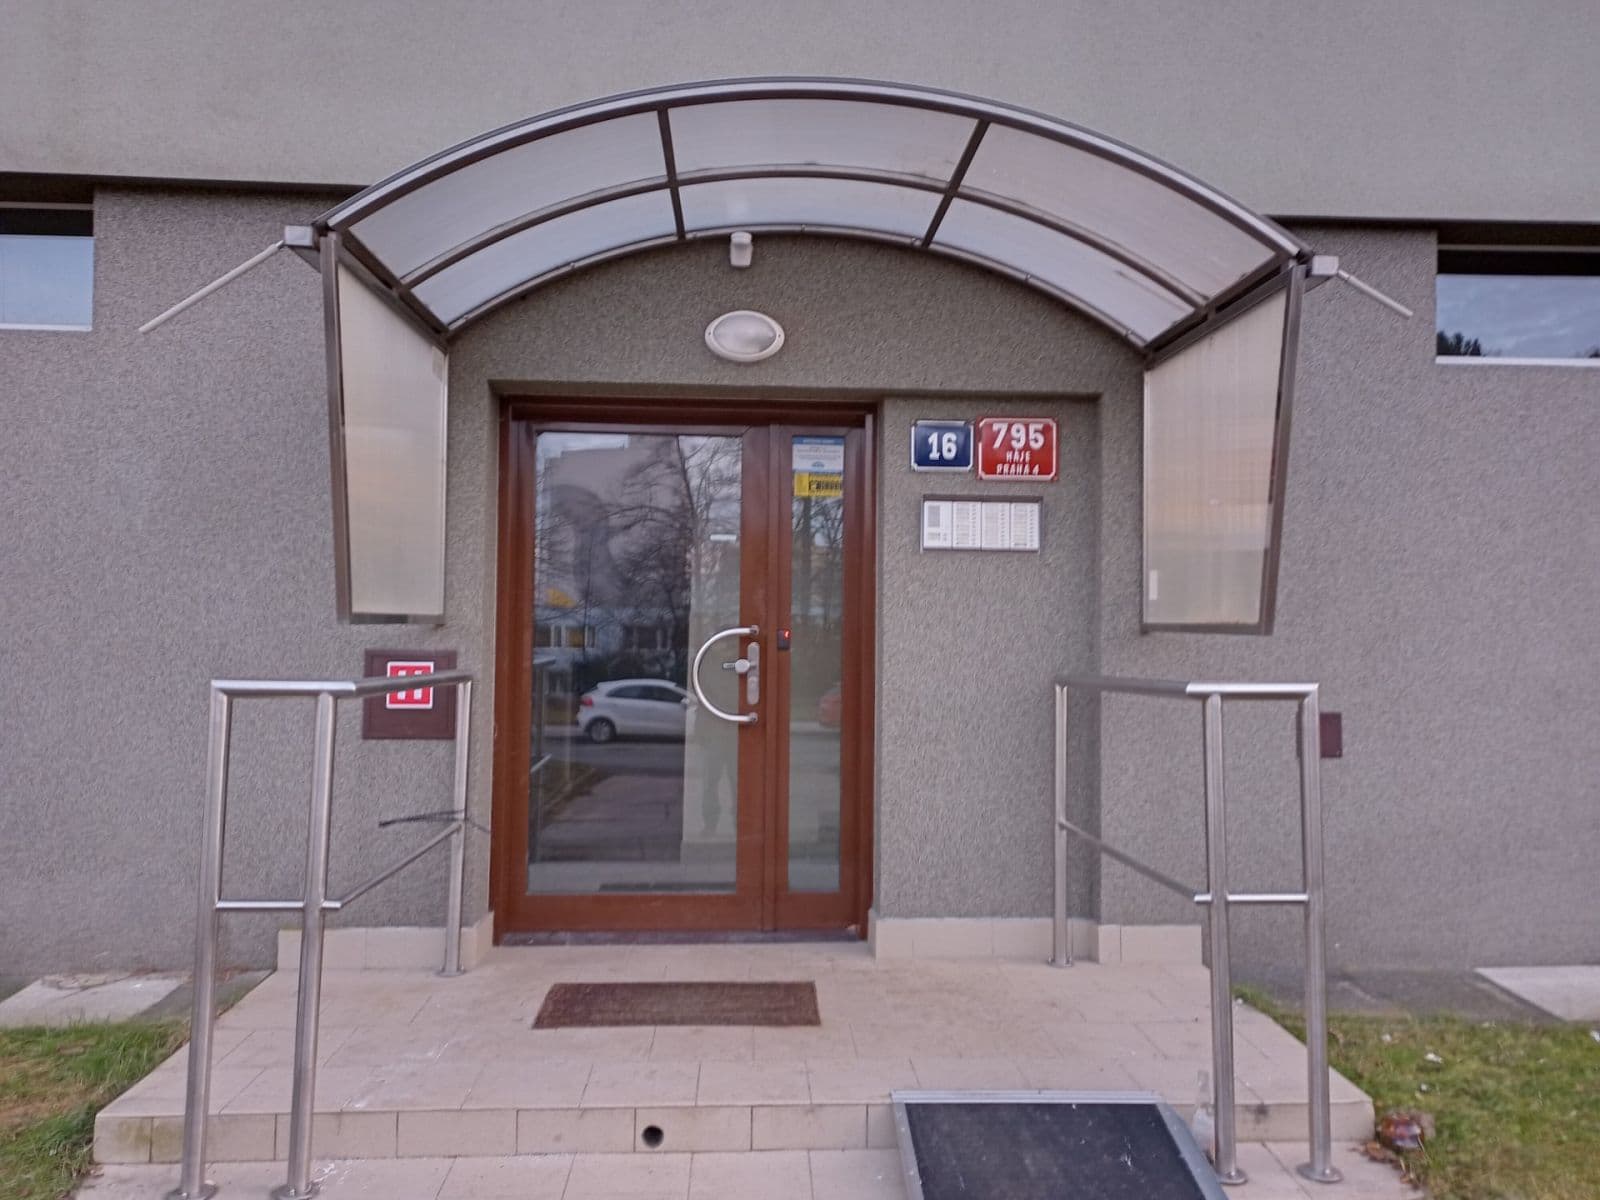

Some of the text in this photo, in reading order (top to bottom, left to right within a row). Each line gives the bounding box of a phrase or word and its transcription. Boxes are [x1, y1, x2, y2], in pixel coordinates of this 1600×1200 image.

[928, 431, 957, 460] 16
[992, 422, 1045, 450] 795
[996, 463, 1040, 475] PRAHA 4
